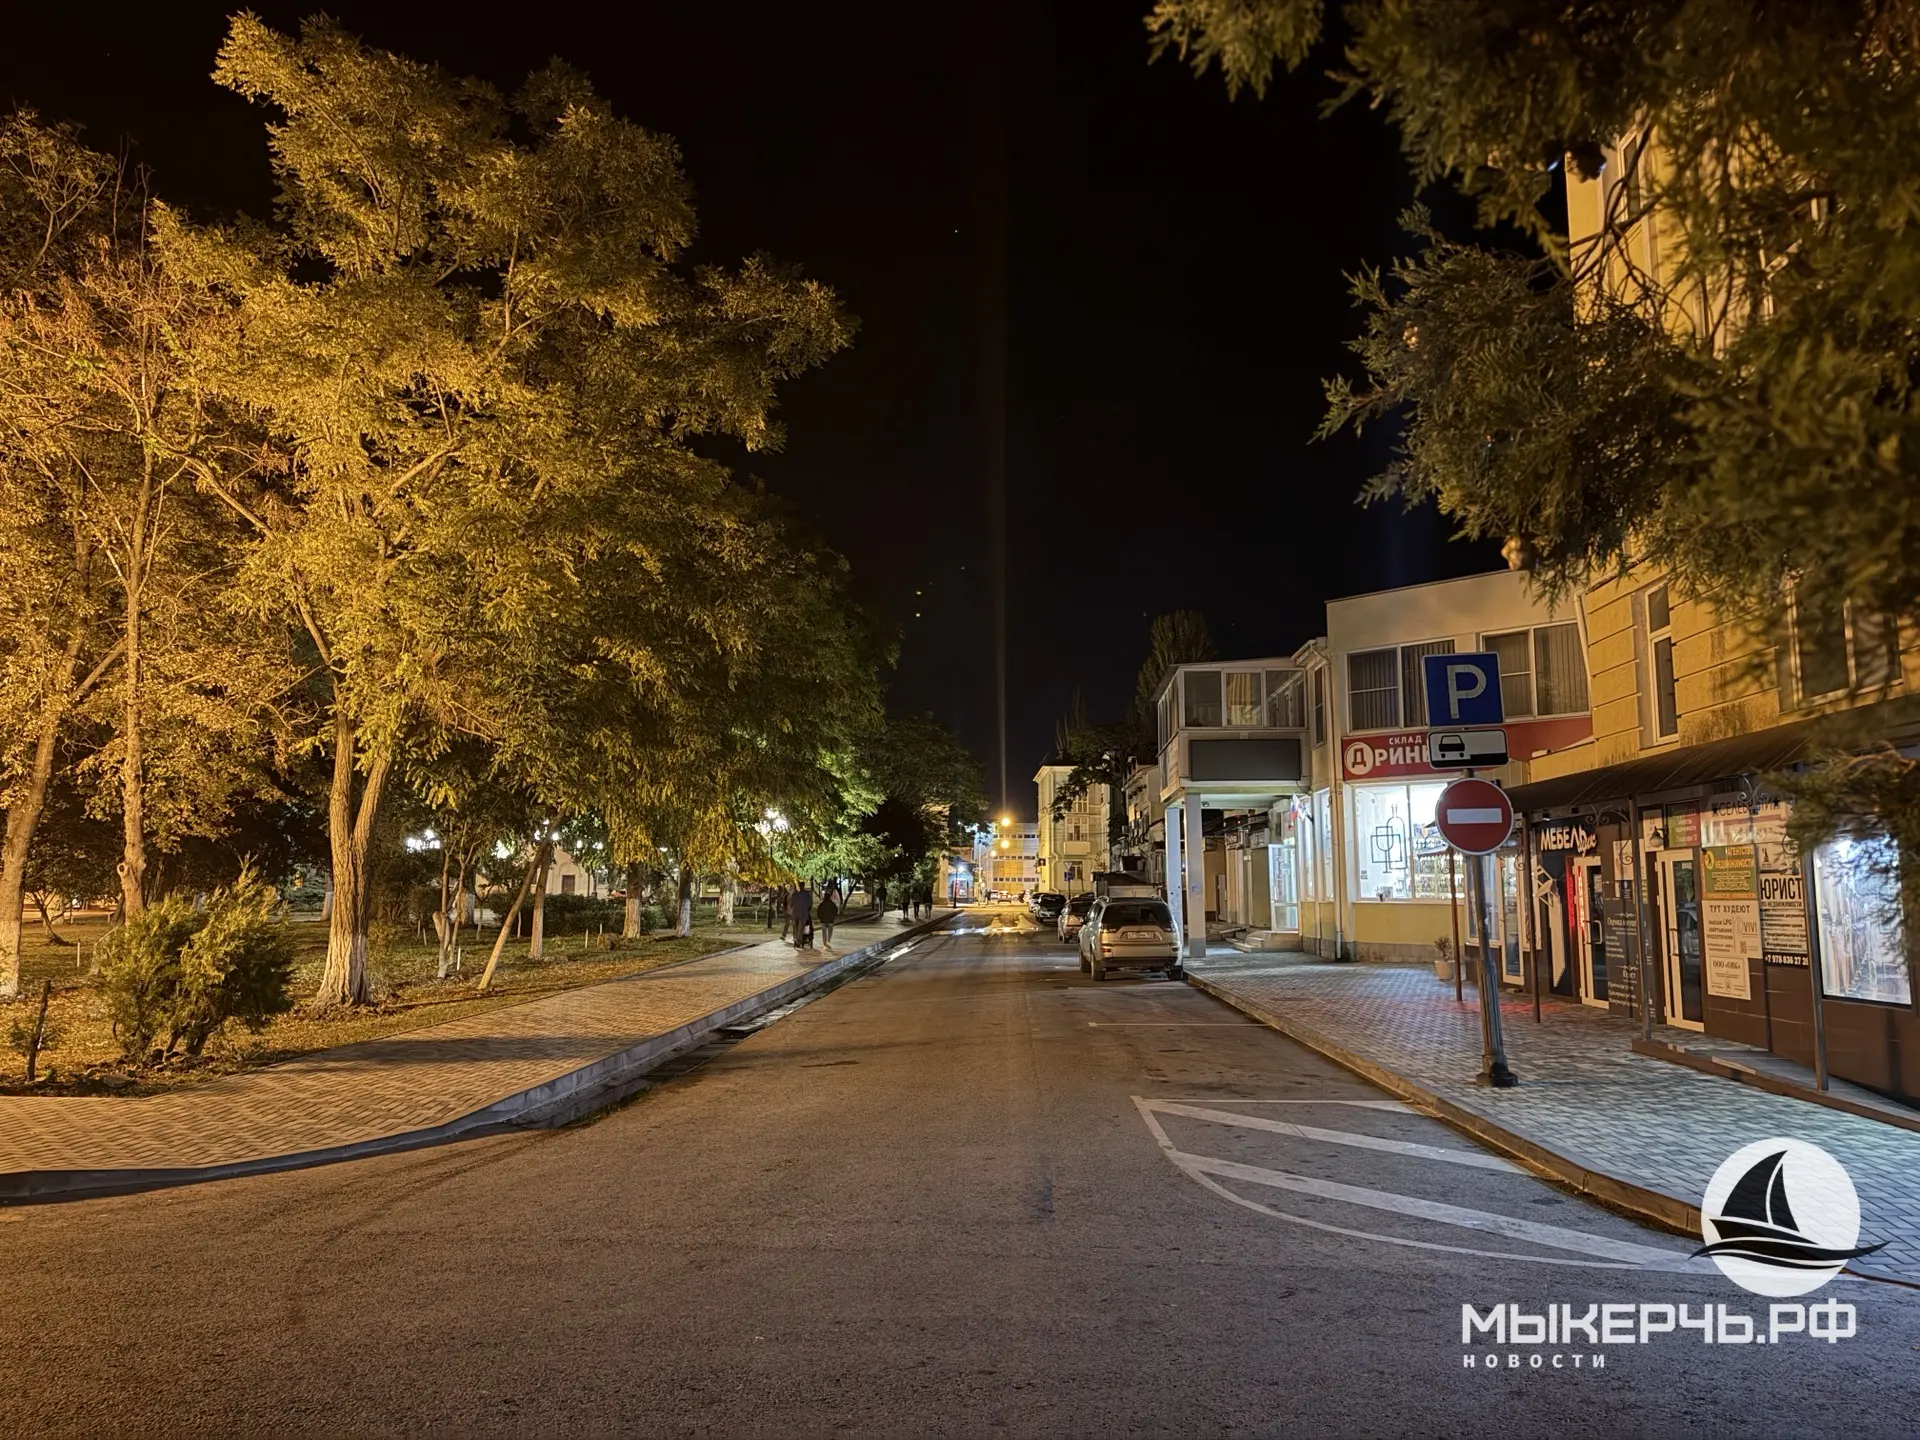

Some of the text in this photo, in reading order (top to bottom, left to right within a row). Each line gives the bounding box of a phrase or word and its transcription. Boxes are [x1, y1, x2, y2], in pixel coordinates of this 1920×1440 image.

[1446, 664, 1487, 720] P
[1389, 735, 1422, 746] СКЛАД
[1760, 878, 1802, 900] ЮРИСТ
[1709, 905, 1750, 915] ТУТ ХУДЕЮТ
